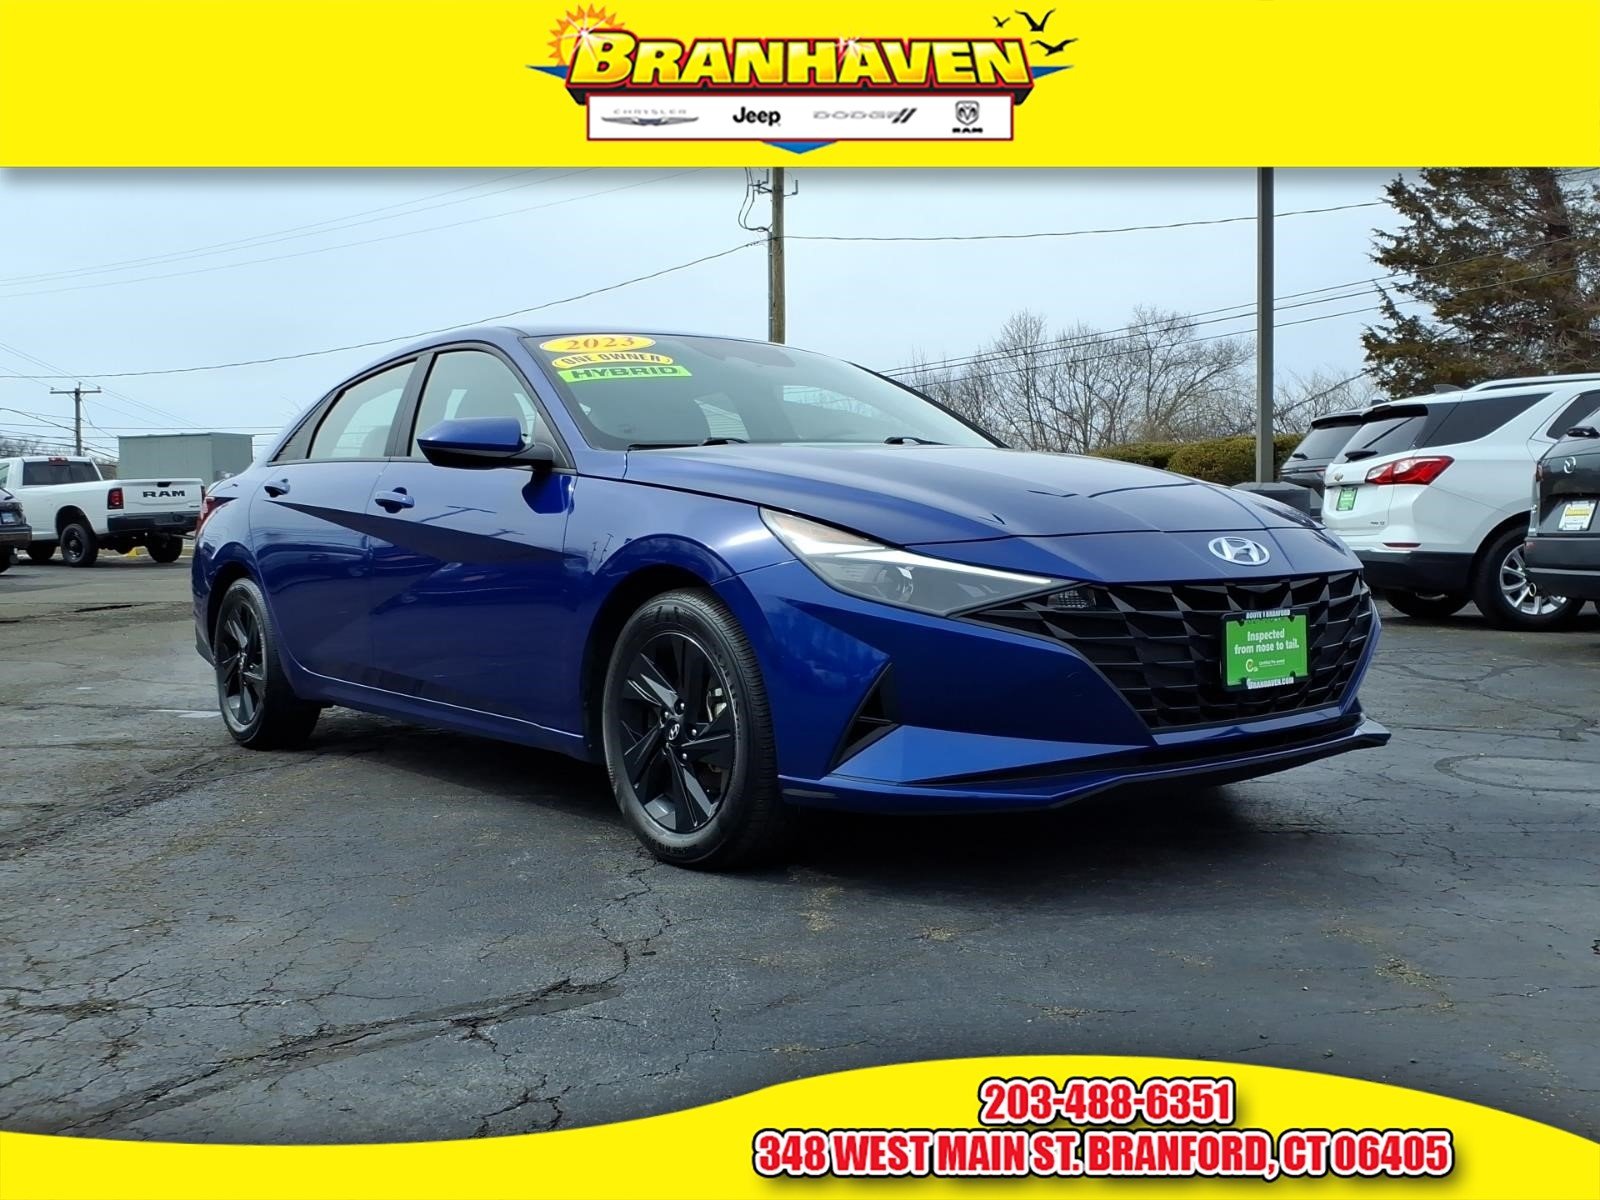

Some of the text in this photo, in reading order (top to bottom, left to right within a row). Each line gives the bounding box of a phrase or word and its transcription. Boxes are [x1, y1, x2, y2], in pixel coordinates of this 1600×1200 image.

[566, 337, 635, 350] 2023
[561, 352, 661, 365] ONE OWNER
[572, 367, 678, 379] HYBRID
[1247, 628, 1285, 642] Inspected
[1234, 644, 1254, 655] from
[1256, 643, 1275, 653] nose
[1276, 642, 1285, 651] to
